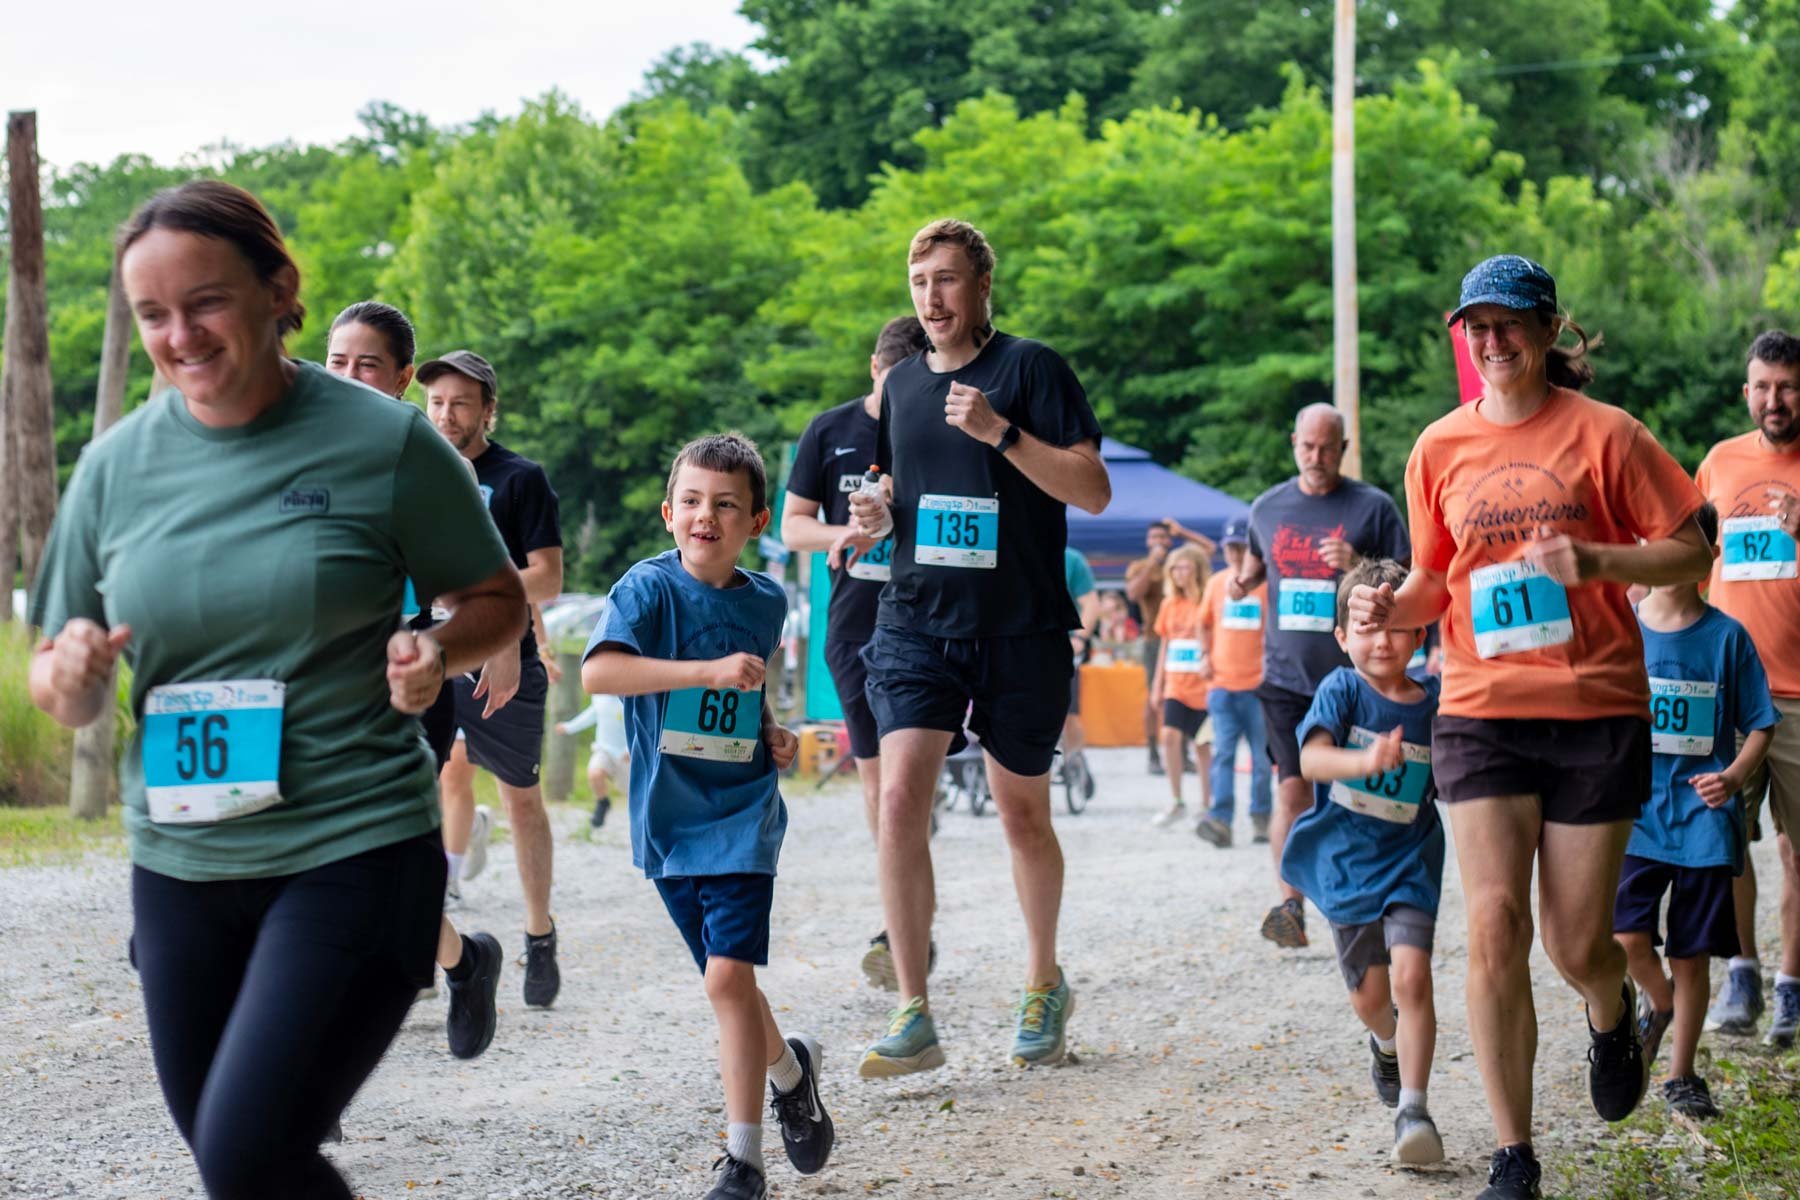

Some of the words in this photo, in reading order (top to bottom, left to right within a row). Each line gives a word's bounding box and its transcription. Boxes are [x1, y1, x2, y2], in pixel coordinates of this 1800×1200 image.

[934, 512, 979, 547] 135
[1454, 496, 1589, 539] Adventure
[1743, 532, 1773, 561] 62
[1293, 591, 1316, 616] 66
[1492, 582, 1534, 627] 61
[698, 688, 739, 735] 68
[1653, 696, 1689, 733] 69
[177, 714, 229, 781] 56
